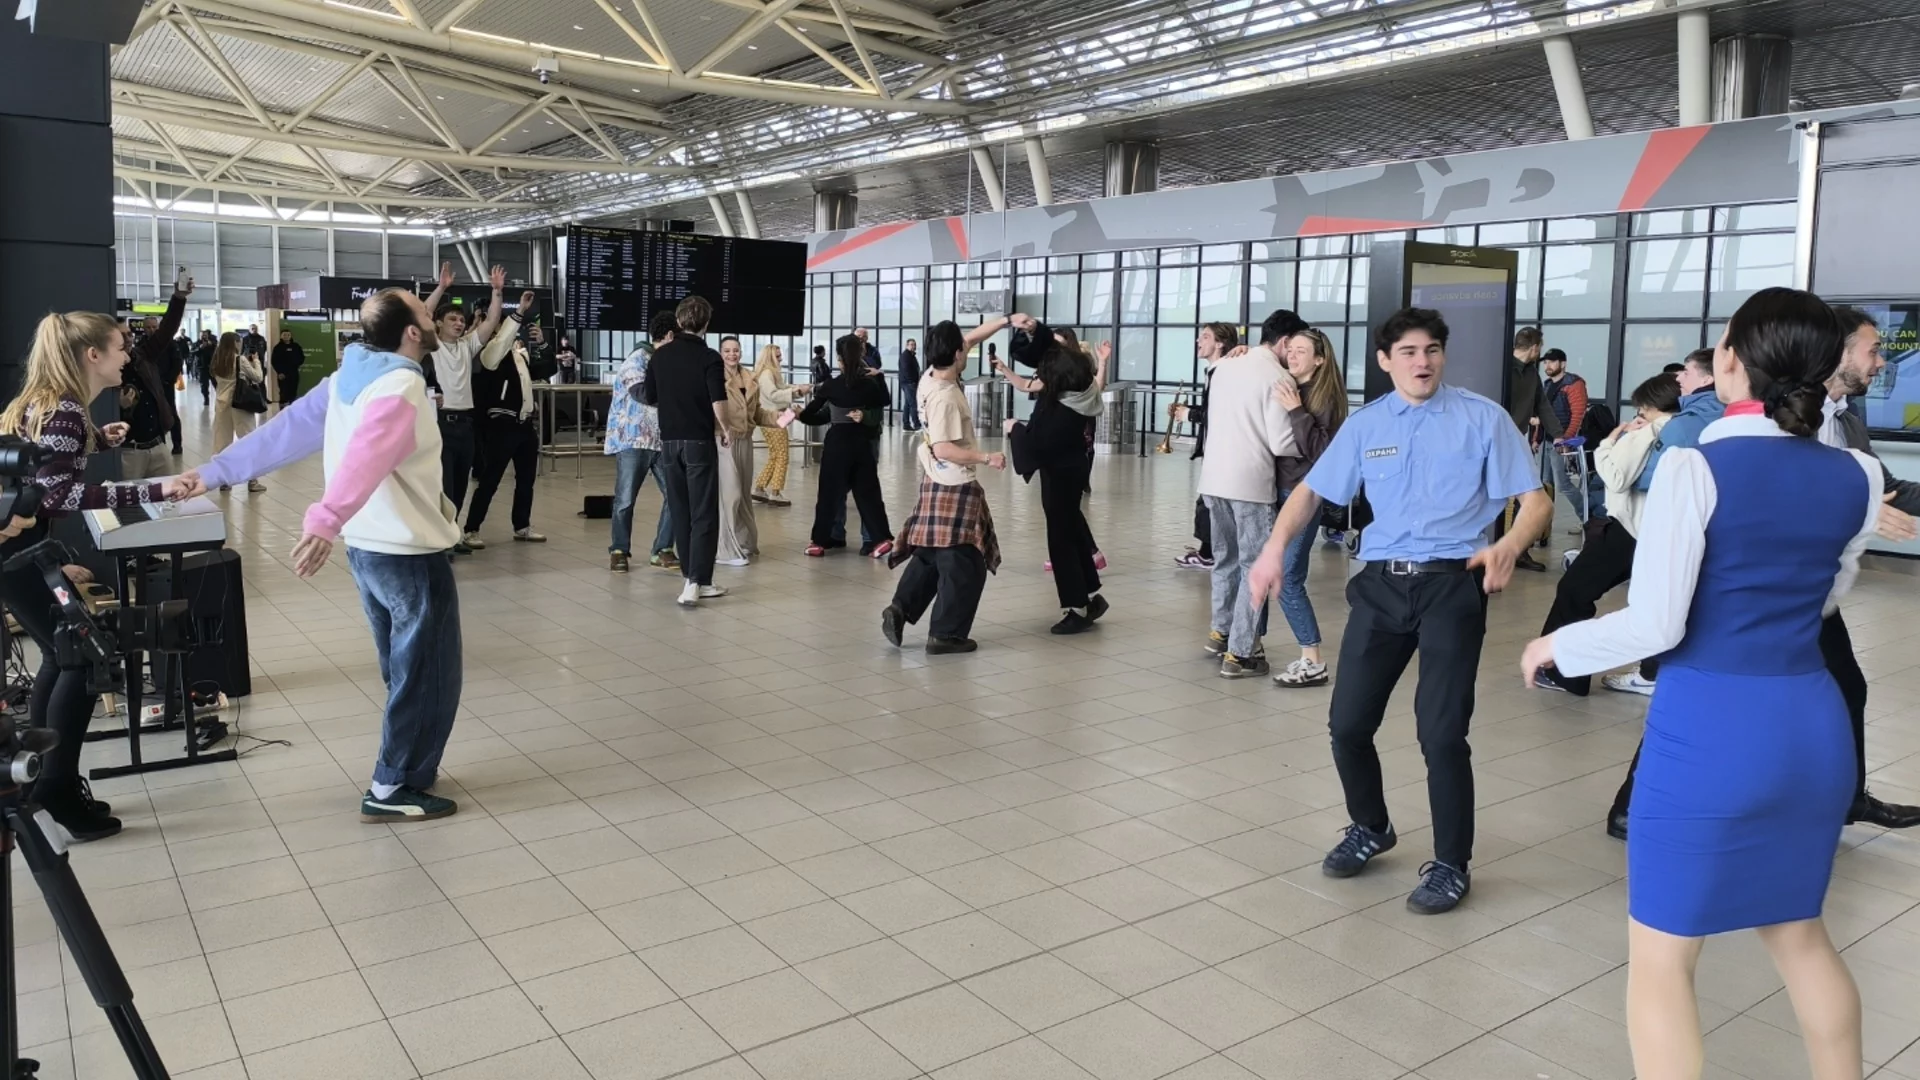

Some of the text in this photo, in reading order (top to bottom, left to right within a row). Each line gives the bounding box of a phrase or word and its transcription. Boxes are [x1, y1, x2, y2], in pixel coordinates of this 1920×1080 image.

[1892, 330, 1917, 338] CAN
[1880, 342, 1920, 350] MOUNT
[1366, 447, 1397, 458] ОХРАНА
